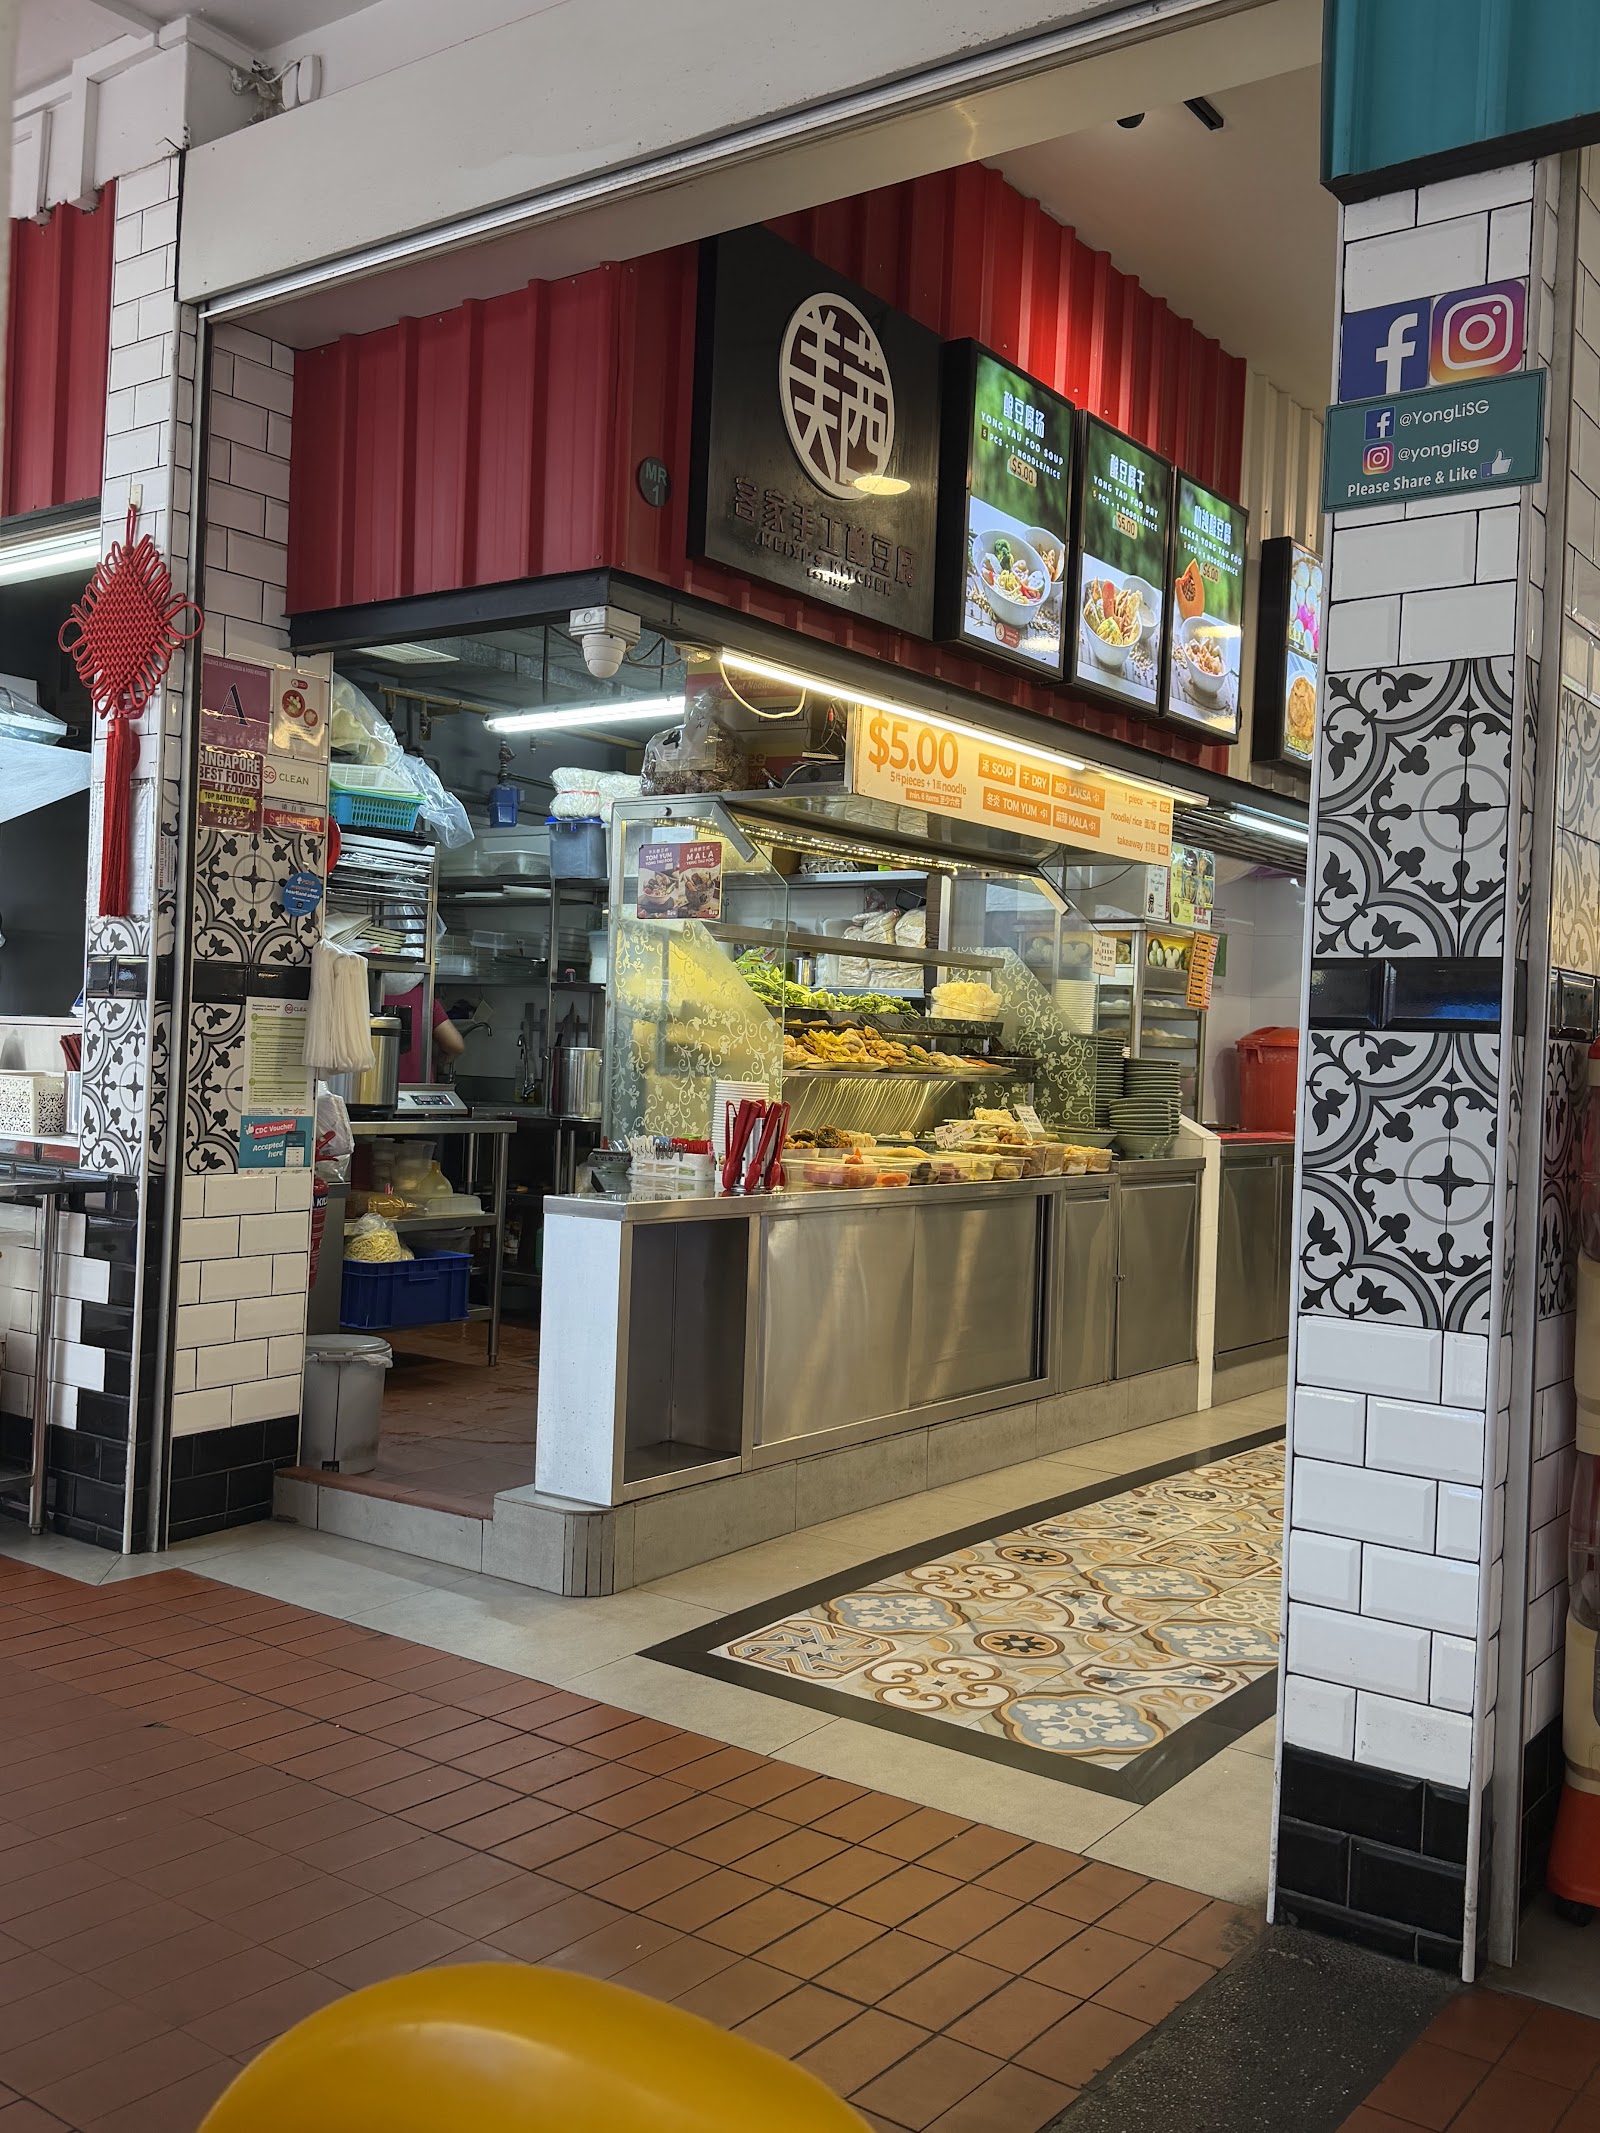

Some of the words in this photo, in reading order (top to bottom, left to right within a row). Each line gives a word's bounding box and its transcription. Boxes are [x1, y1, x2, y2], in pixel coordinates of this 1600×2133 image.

[1400, 400, 1489, 427] @YongLiSG
[981, 411, 1003, 431] YONG
[1007, 427, 1022, 441] TAU
[1025, 438, 1040, 452] FOO
[1044, 449, 1063, 465] SOUP
[1398, 437, 1480, 462] @yonglisg
[989, 433, 1002, 446] PCS
[1017, 449, 1060, 479] NOODLE/RICE
[645, 462, 667, 486] MR
[1011, 457, 1034, 484] $5.00
[1347, 481, 1390, 497] Please
[1393, 475, 1431, 490] Share
[1435, 471, 1444, 483] &
[1449, 465, 1477, 482] Like
[652, 486, 660, 504] 1
[1093, 475, 1112, 492] YONG
[1115, 488, 1128, 501] TAU
[1130, 497, 1143, 509] FOO
[1146, 505, 1158, 518] DRY
[1098, 493, 1109, 505] PCS
[1121, 506, 1157, 532] NOODLE/RICE
[1117, 514, 1135, 536] $5.00
[1180, 525, 1198, 543] LAKSA
[1201, 537, 1216, 551] YONG
[1218, 547, 1229, 558] TAU
[1231, 553, 1242, 565] FOO
[830, 560, 890, 597] KITCHEN
[214, 682, 250, 727] A
[868, 712, 958, 779] $5.00
[200, 750, 260, 774] SINGAPORE
[215, 783, 242, 794] ENJOY
[226, 770, 258, 787] FOODS
[279, 772, 309, 785] CLEAN
[992, 763, 1013, 778] SOUP
[1031, 775, 1047, 789] DRY
[1069, 786, 1091, 802] LAKSA
[204, 791, 214, 799] TOP
[216, 793, 232, 802] RATED
[1129, 794, 1143, 805] piece
[1002, 797, 1019, 812] TOM
[1021, 802, 1037, 817] YUM
[1068, 815, 1088, 830] MALA
[1132, 816, 1142, 826] rice
[1117, 836, 1143, 851] takeaway
[269, 1123, 293, 1132] Voucher
[252, 1140, 285, 1152] Accepted
